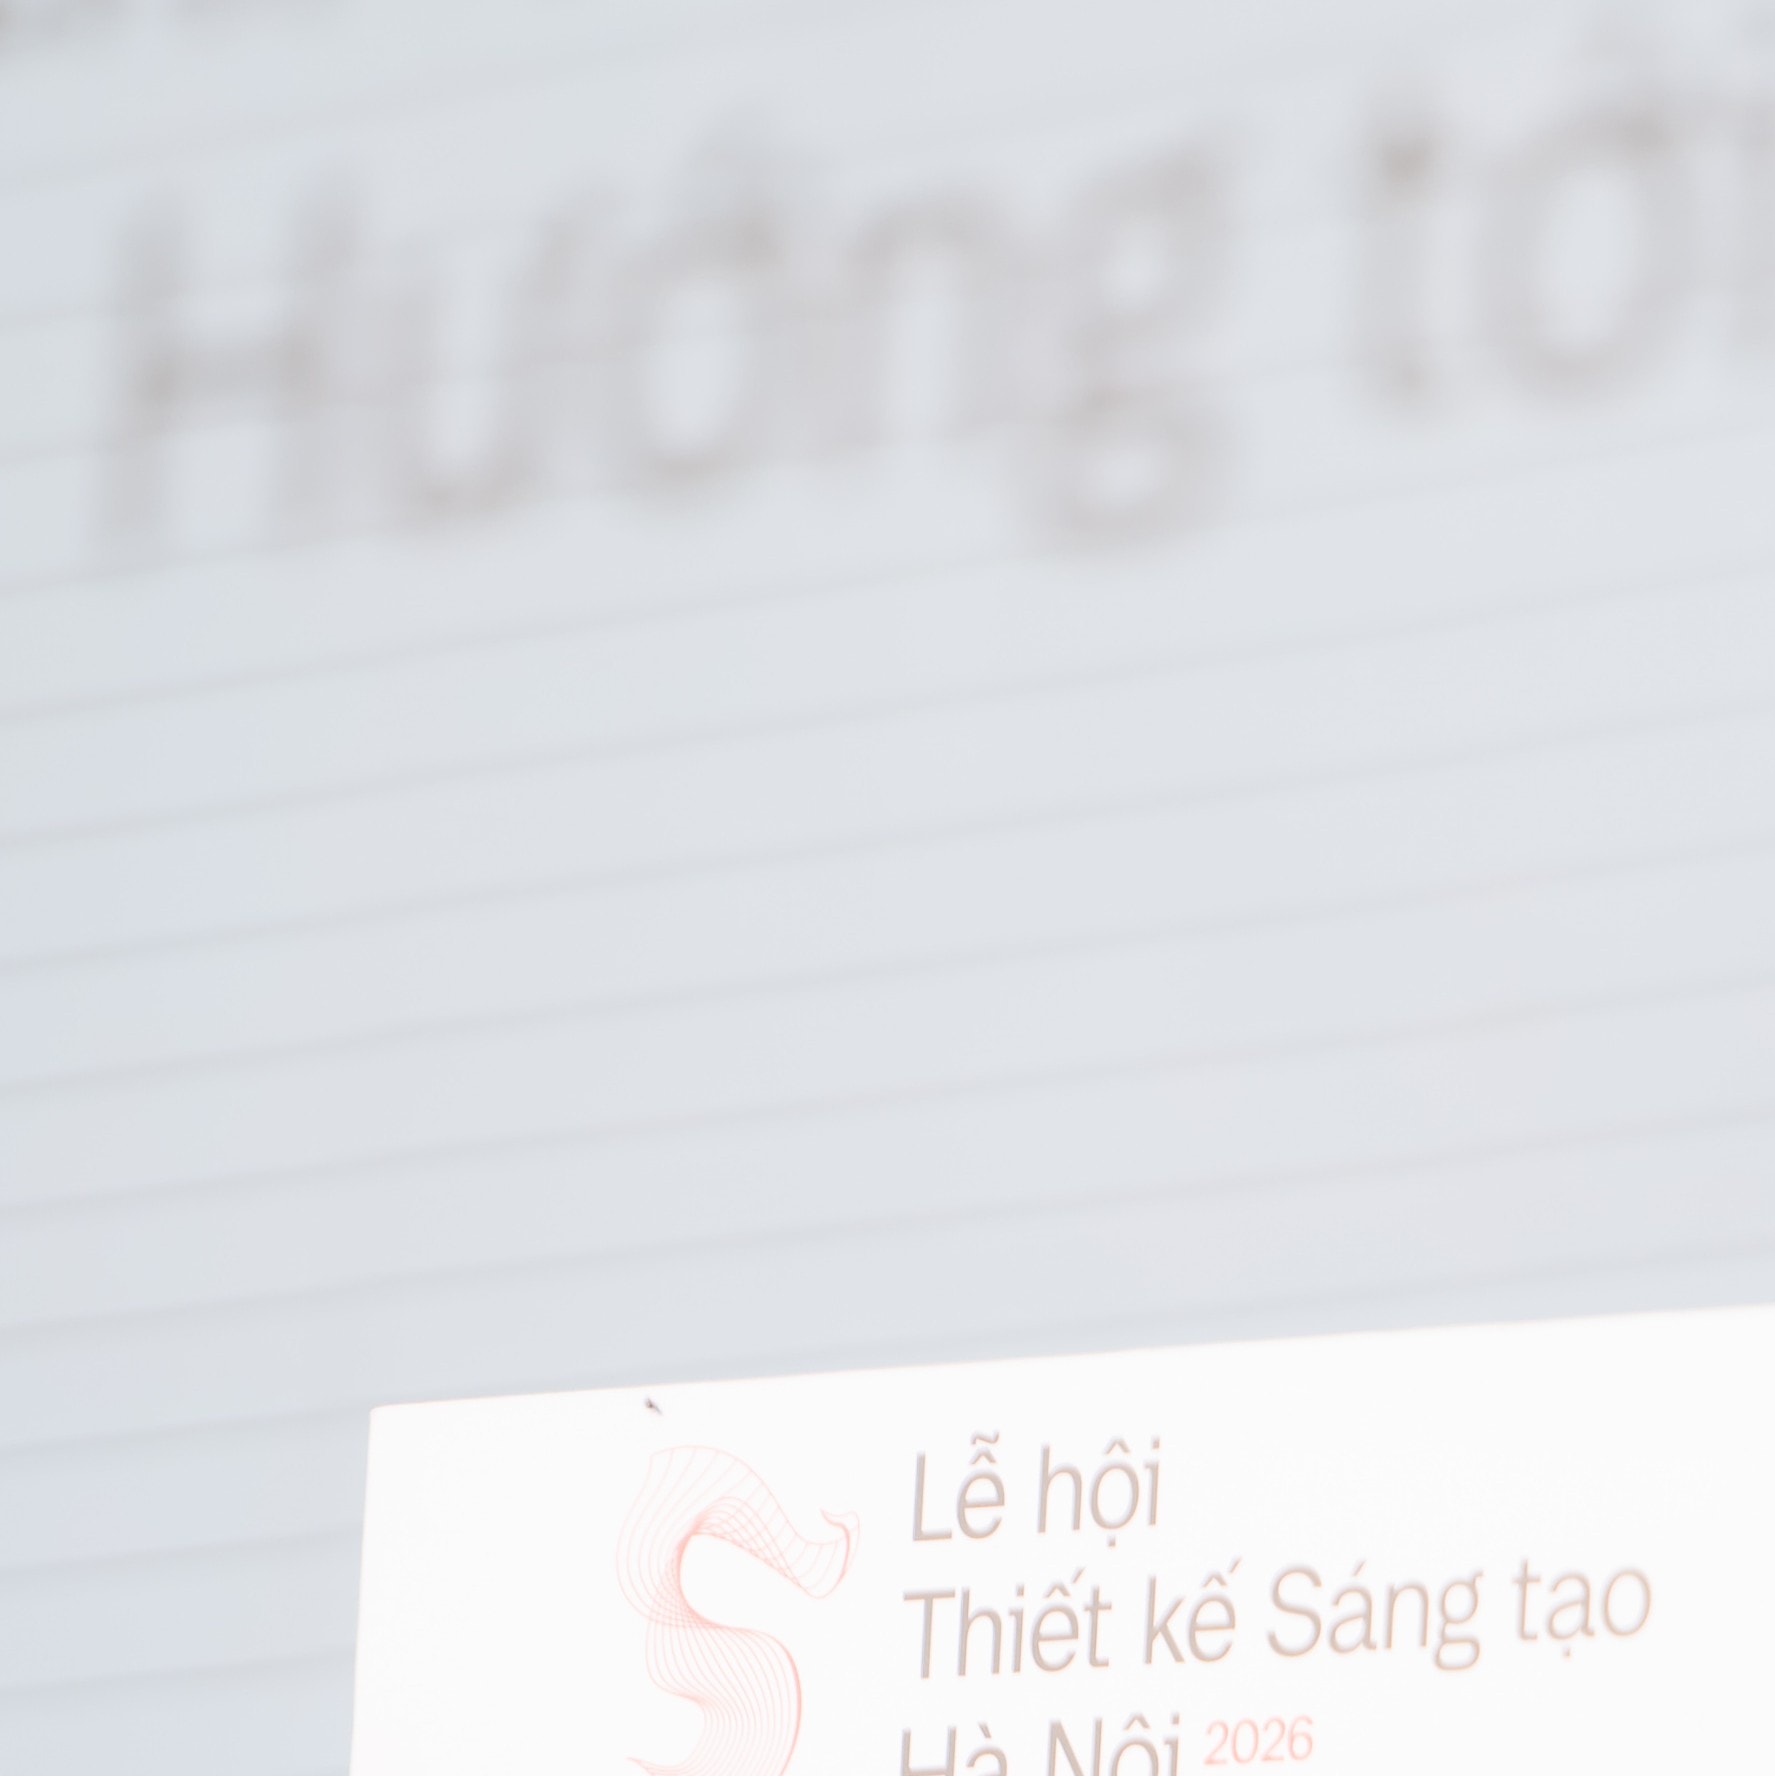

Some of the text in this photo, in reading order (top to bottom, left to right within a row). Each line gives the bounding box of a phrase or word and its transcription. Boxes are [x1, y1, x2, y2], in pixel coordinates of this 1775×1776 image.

[911, 1430, 1162, 1551] Lễ hội
[902, 1556, 1654, 1681] Thiết kế Sáng tạo
[1202, 1713, 1315, 1768] 2026
